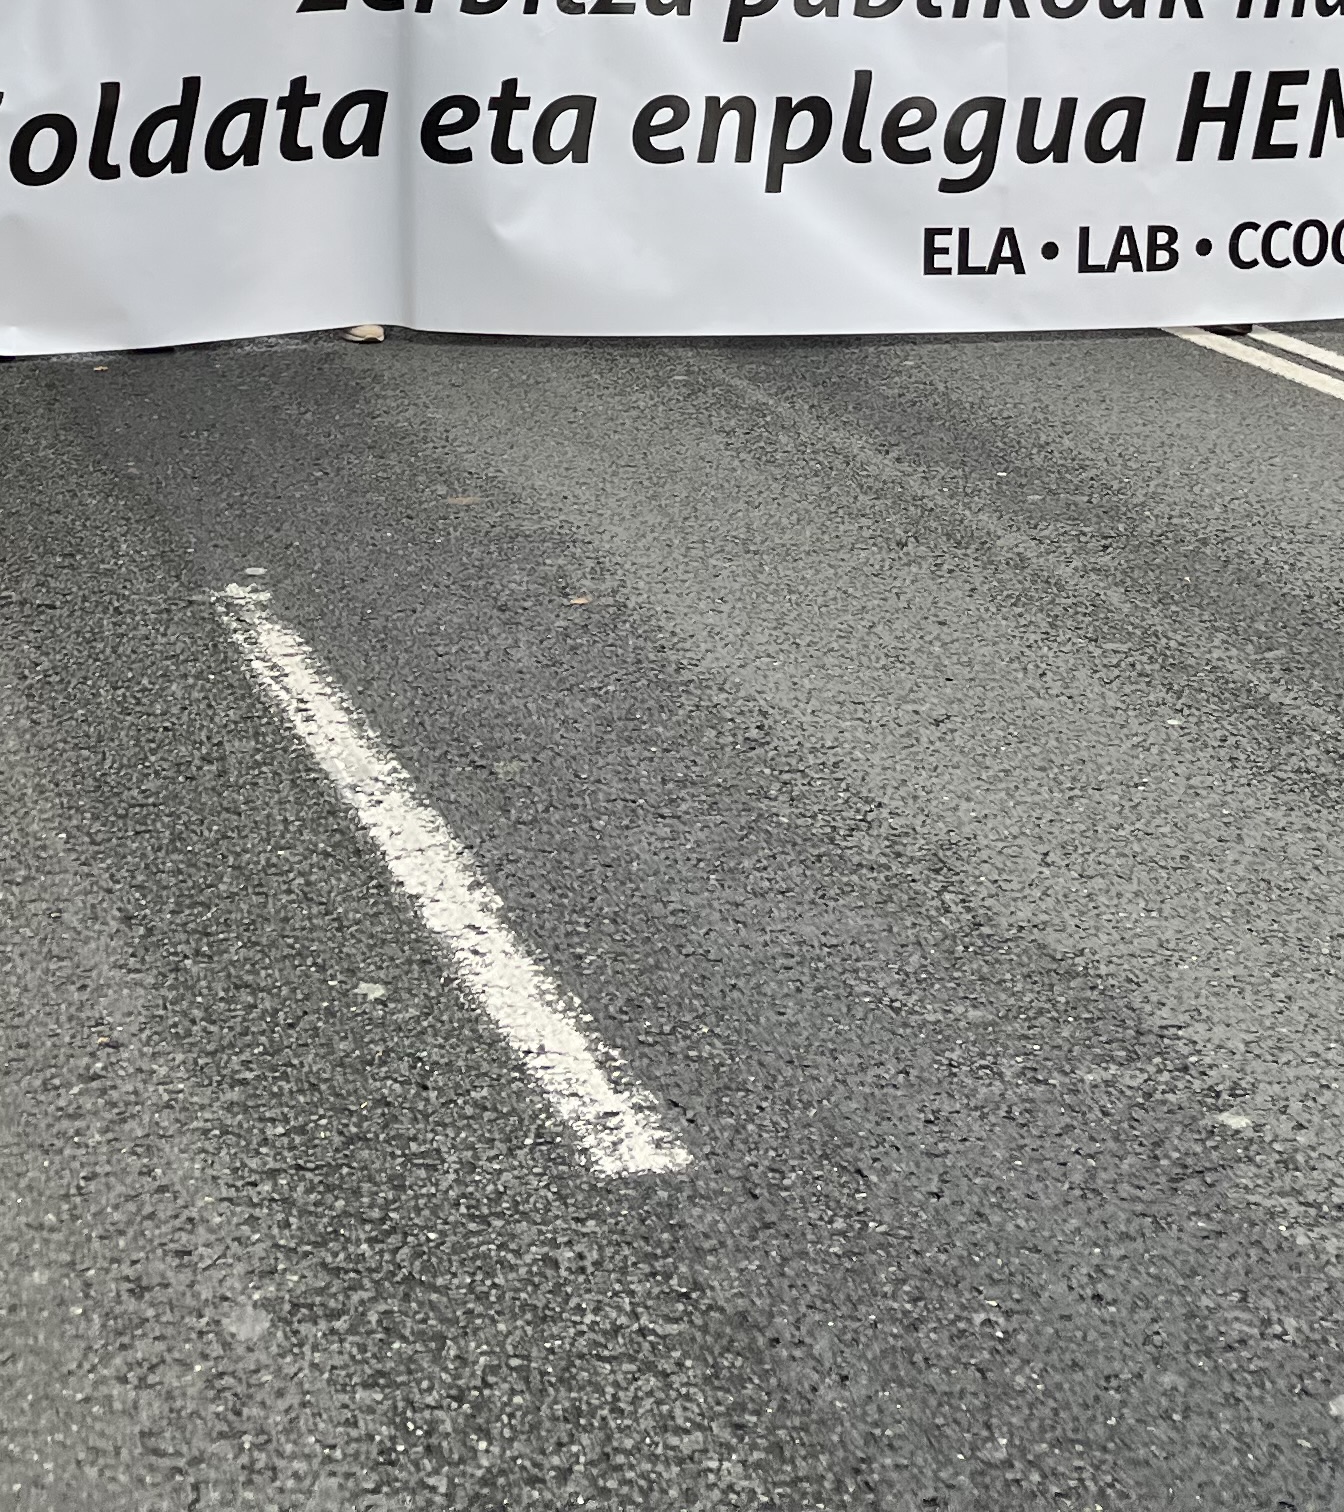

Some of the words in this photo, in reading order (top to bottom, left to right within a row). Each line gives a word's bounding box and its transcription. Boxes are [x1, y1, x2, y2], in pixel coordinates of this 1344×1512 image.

[421, 78, 596, 164] eta
[633, 70, 1145, 193] enplegua
[924, 226, 1025, 275] ELA
[1078, 224, 1178, 273] LAB
